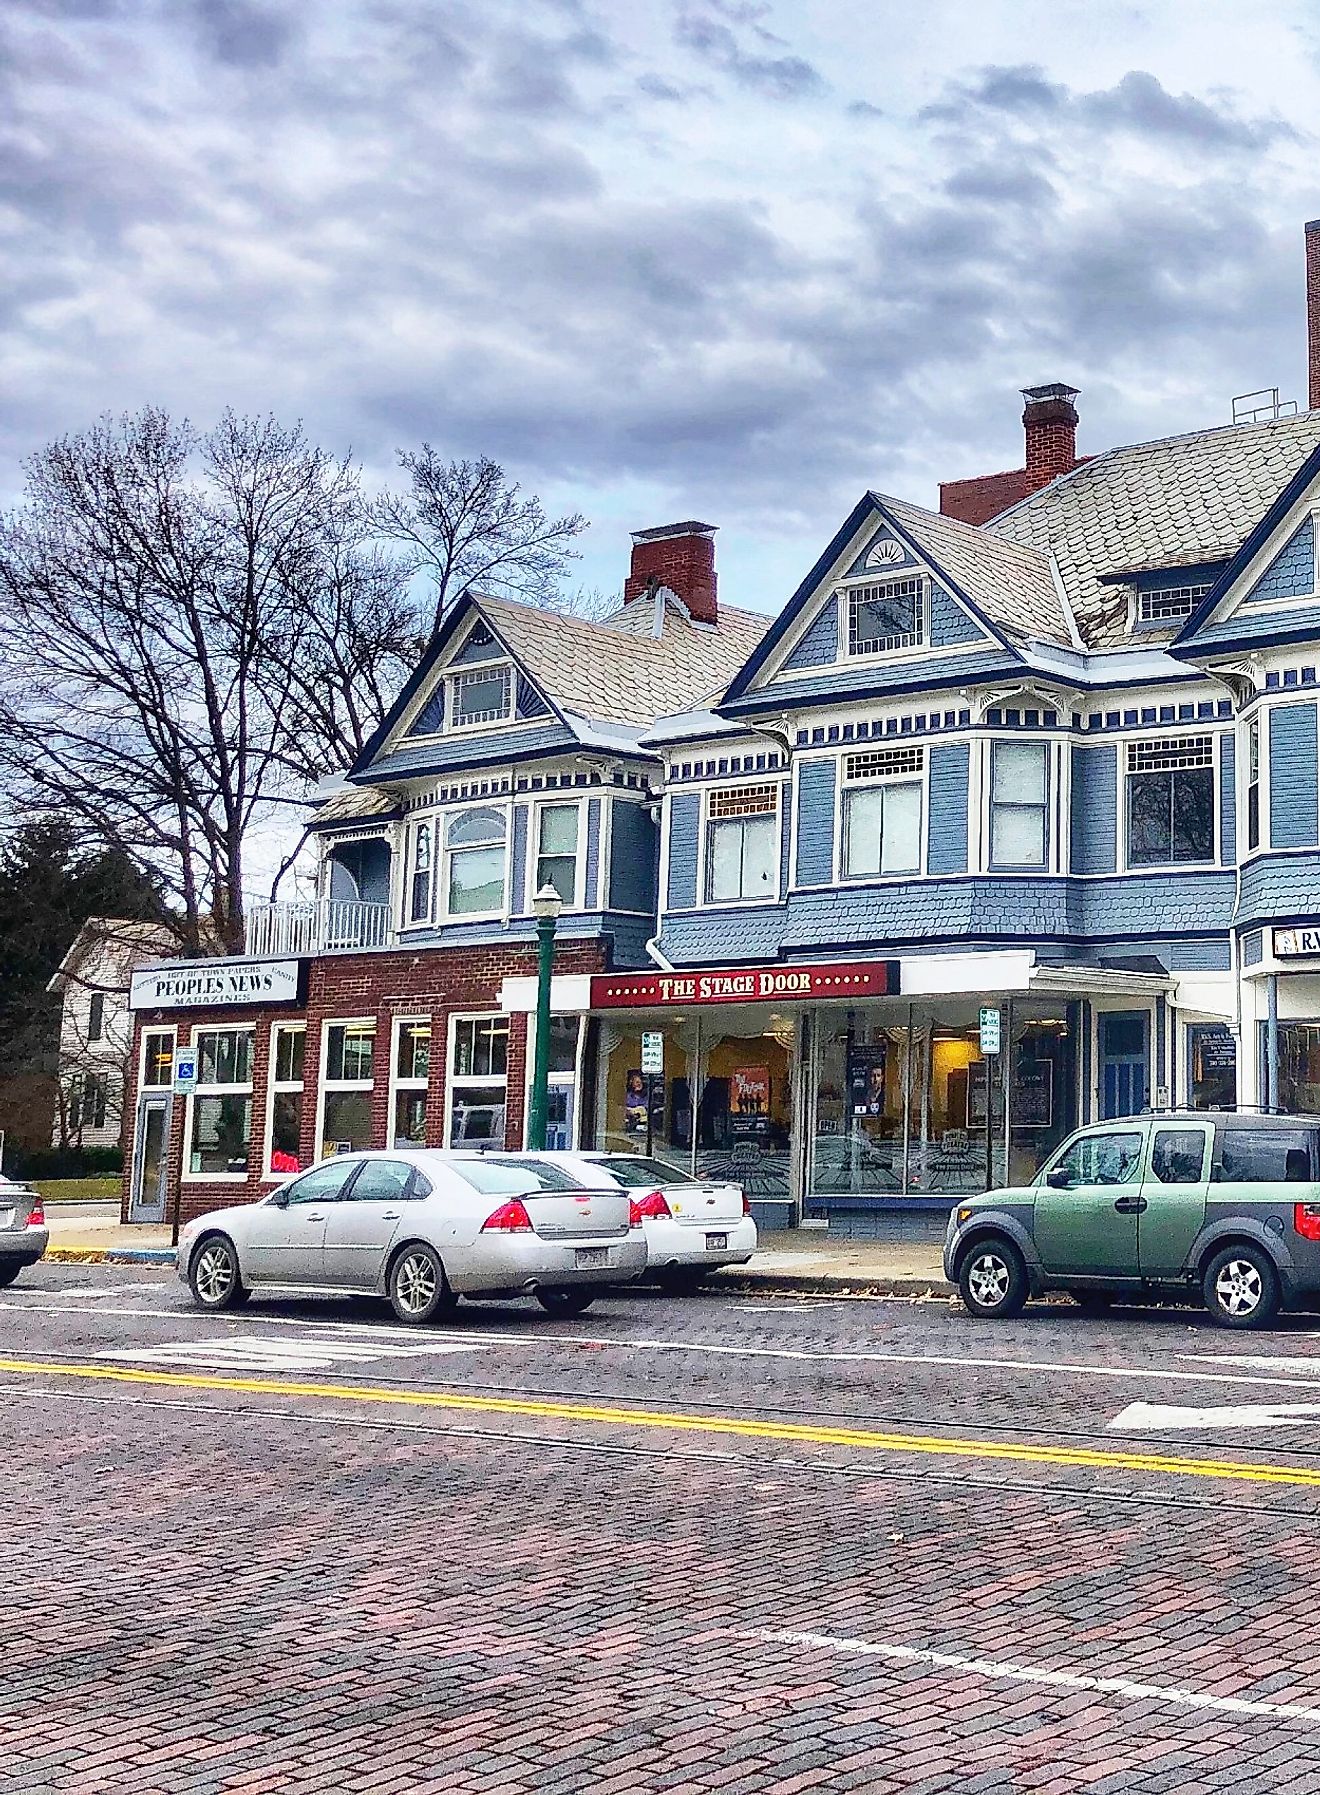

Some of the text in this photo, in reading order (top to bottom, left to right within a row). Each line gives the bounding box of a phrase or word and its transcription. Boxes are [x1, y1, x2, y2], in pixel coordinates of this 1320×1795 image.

[155, 974, 273, 997] PEOPLES NEWS
[659, 973, 811, 1000] THE STAGE DOOR
[174, 994, 251, 1005] MAGAZINES
